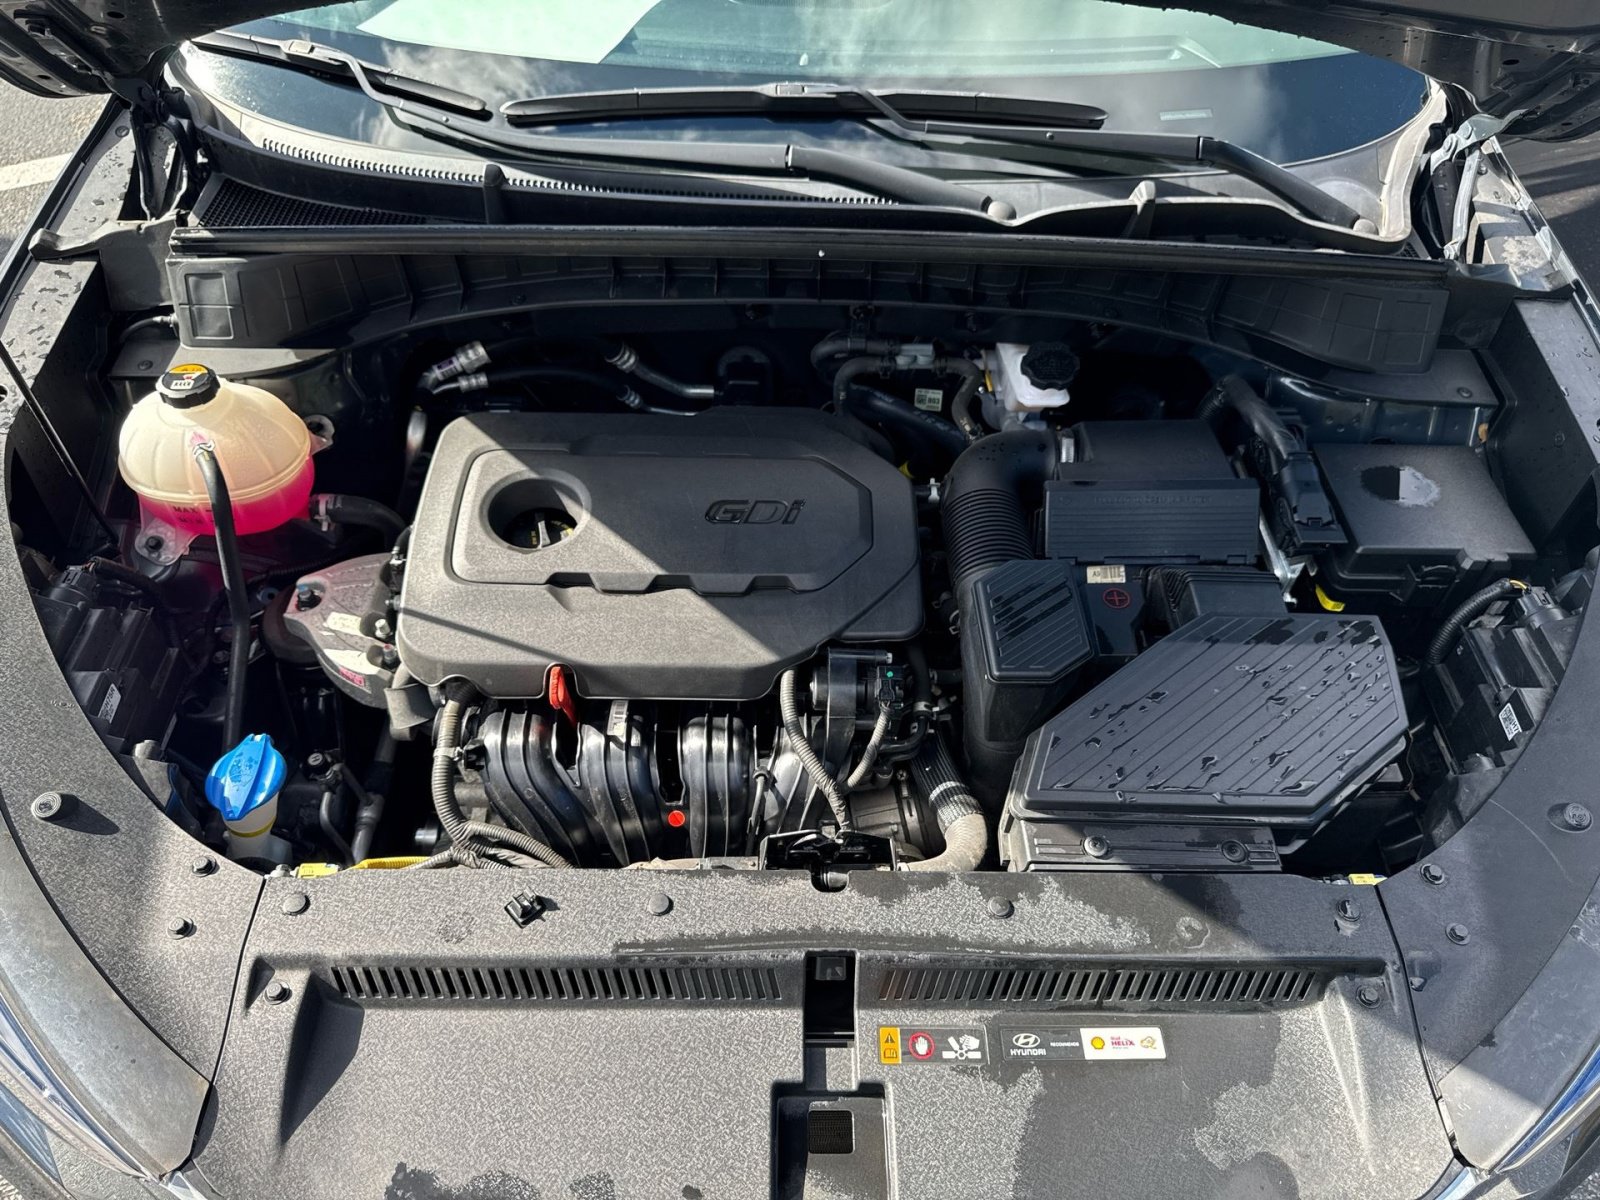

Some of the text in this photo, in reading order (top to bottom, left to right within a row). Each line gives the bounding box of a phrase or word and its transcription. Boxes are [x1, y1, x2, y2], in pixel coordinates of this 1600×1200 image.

[172, 506, 198, 514] MAX
[704, 498, 807, 525] GDi
[1009, 1048, 1047, 1056] HYUNDAI
